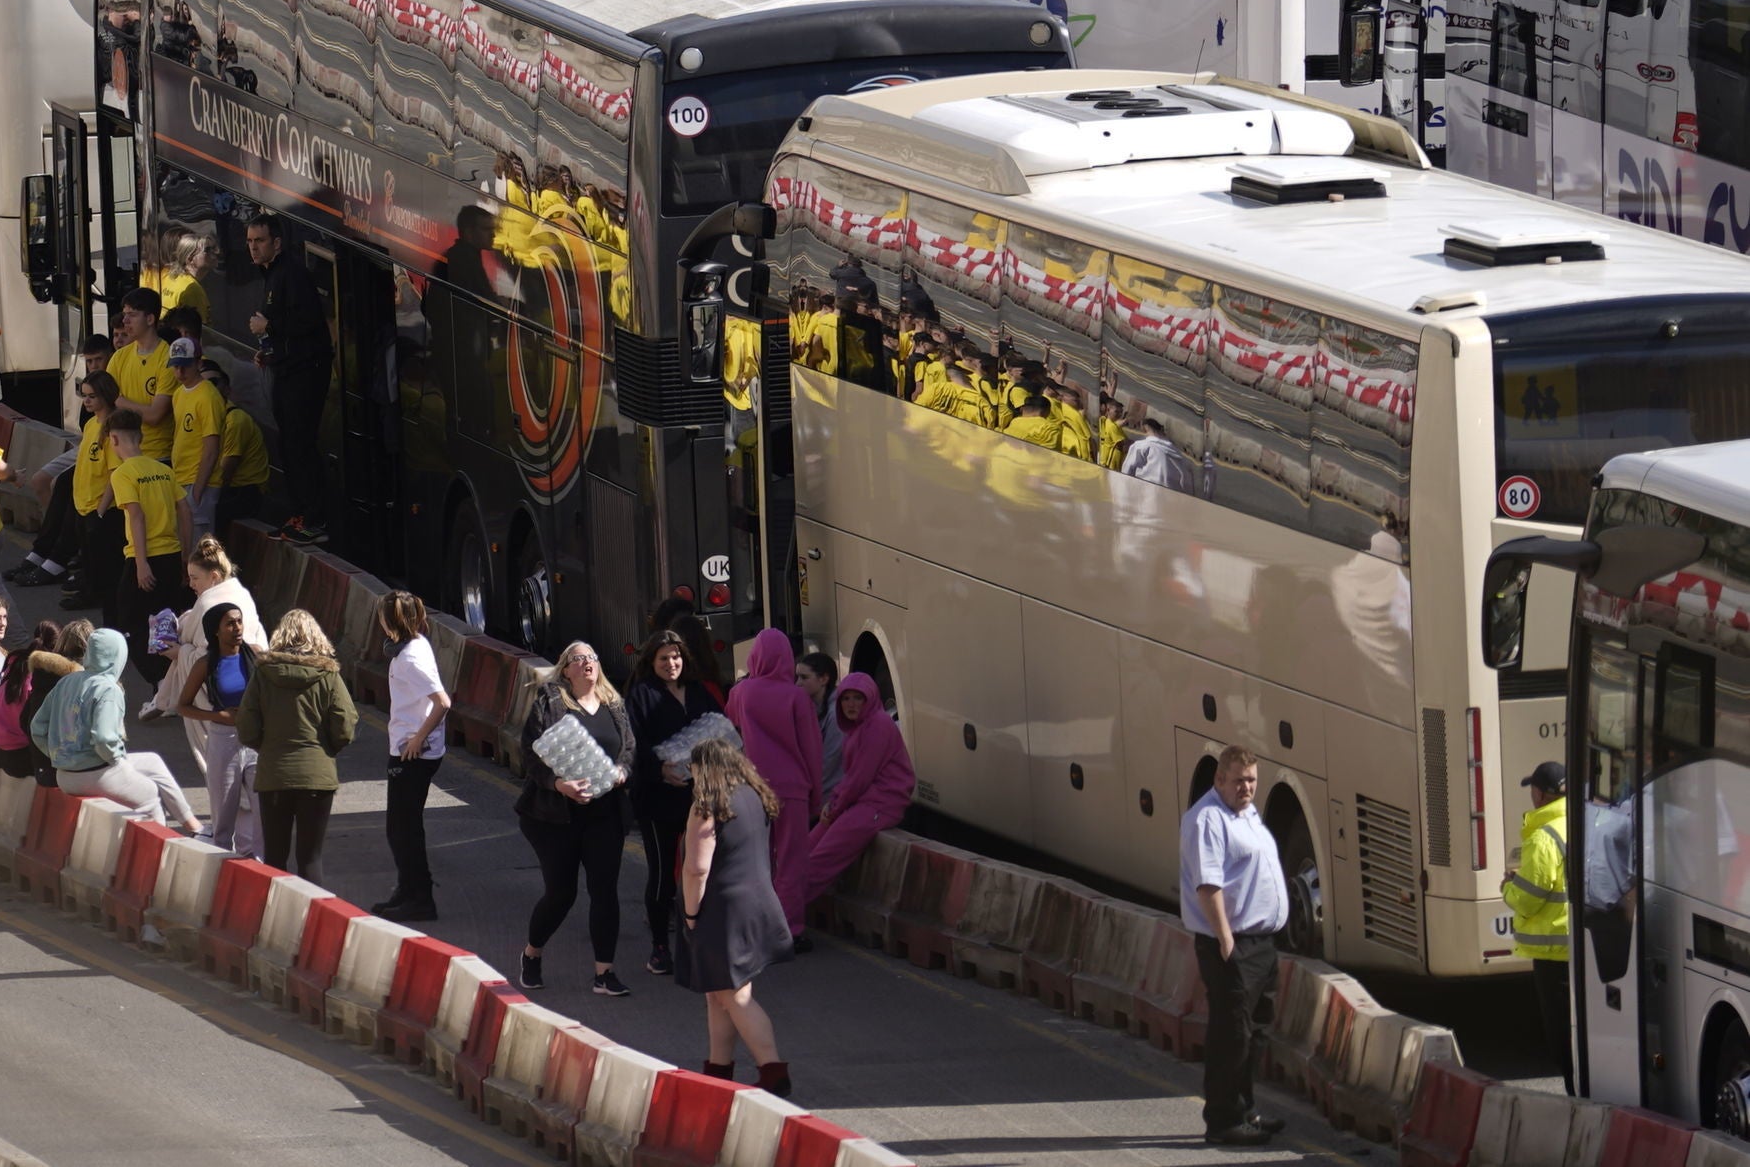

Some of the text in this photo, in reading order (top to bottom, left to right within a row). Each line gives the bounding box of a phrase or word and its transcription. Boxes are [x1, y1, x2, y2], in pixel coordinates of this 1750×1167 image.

[671, 107, 706, 124] 100
[190, 76, 373, 205] CRANBERRY COACHWAYS
[1618, 147, 1750, 255] RIDLEY
[1509, 488, 1530, 506] 80
[707, 560, 730, 577] UK
